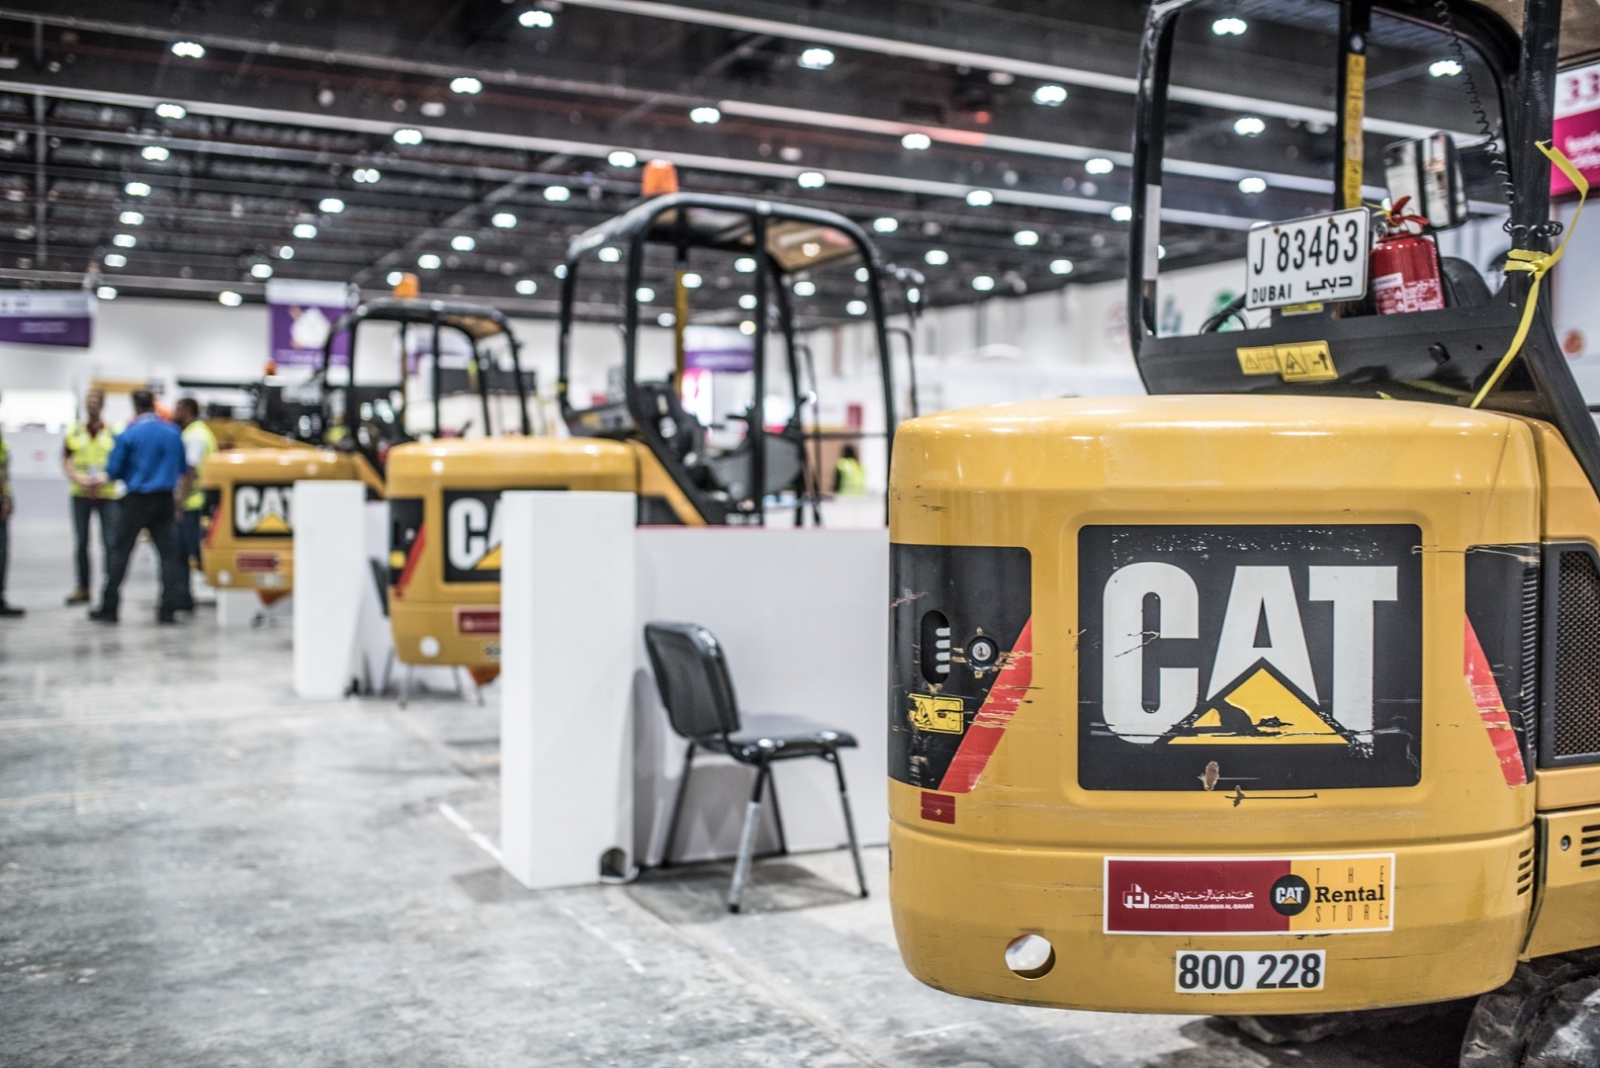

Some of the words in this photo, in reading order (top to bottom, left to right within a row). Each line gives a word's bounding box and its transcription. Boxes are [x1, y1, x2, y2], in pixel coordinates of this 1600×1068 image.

[1253, 237, 1265, 275] J
[1277, 219, 1359, 272] 83463
[1251, 283, 1293, 304] DUBAI
[1306, 275, 1353, 296] دبي
[1102, 561, 1399, 744] CAT
[1315, 865, 1385, 885] THE
[1275, 886, 1305, 904] CAT
[1314, 884, 1386, 904] Rental
[1178, 953, 1245, 990] 800
[1256, 953, 1321, 989] 228
